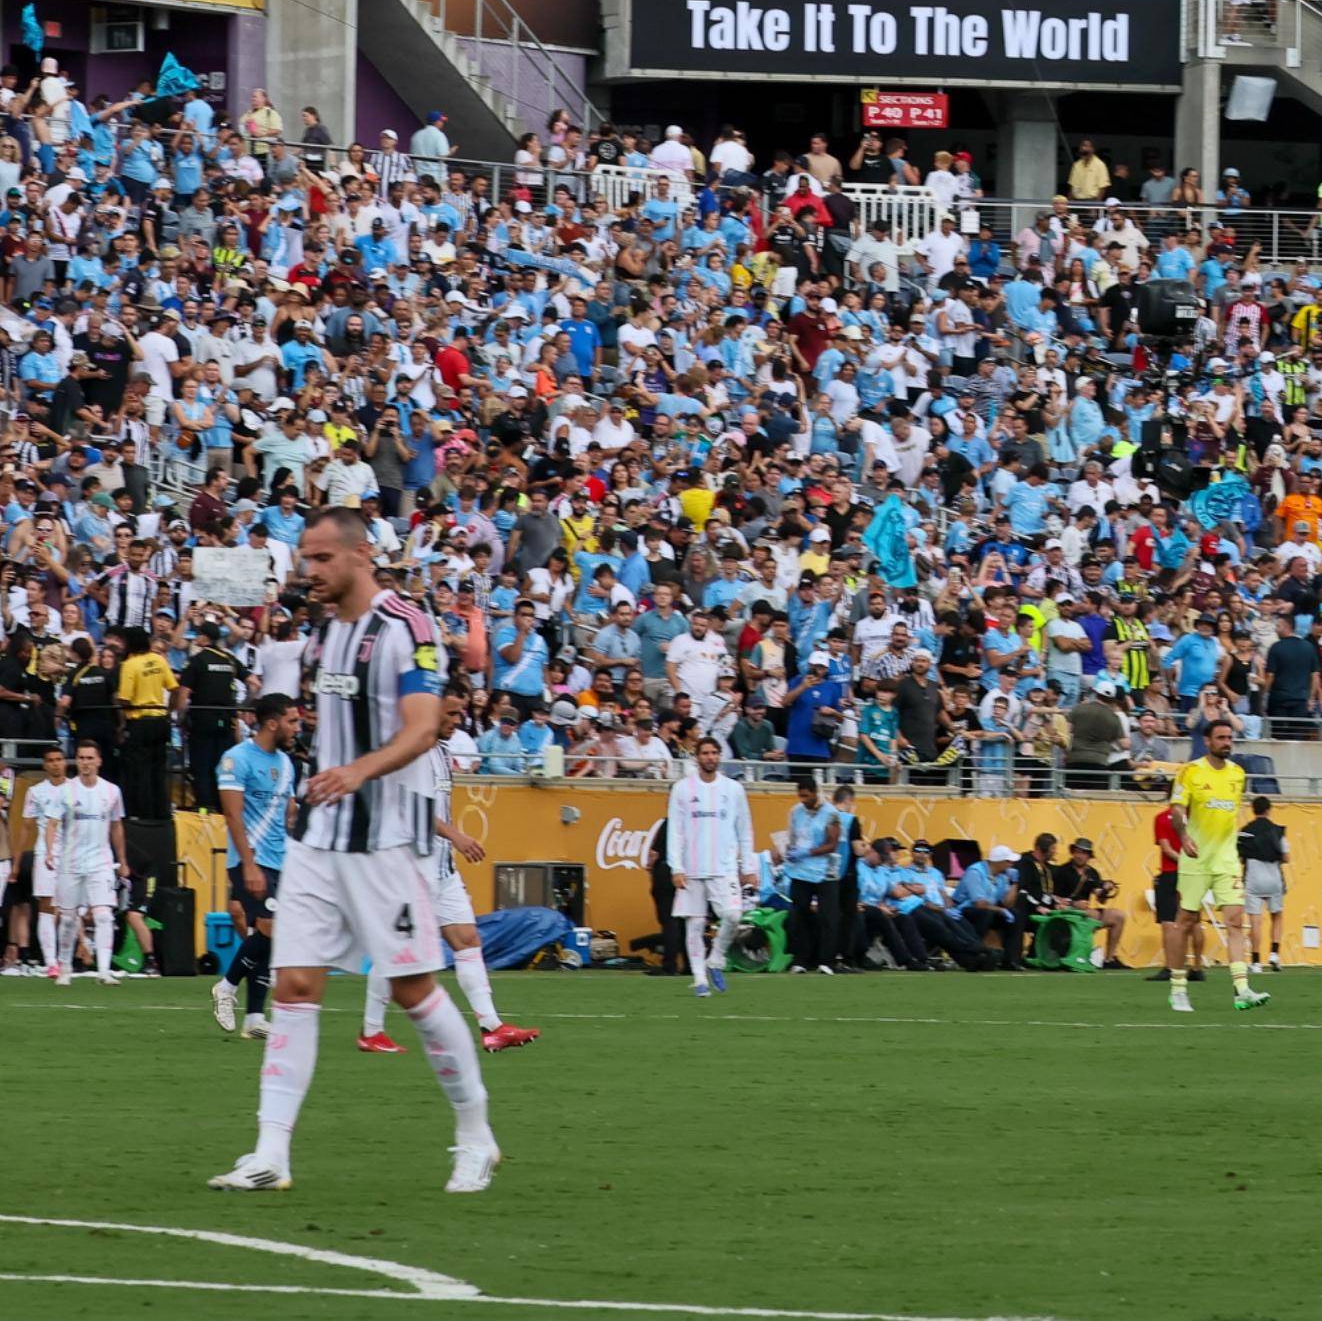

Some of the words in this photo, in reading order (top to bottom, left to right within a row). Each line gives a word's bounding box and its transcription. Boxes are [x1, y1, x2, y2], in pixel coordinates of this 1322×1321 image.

[687, 0, 791, 52] Take
[804, 3, 836, 53] It
[848, 4, 896, 55] To
[910, 6, 988, 57] The
[1001, 9, 1130, 62] World
[879, 95, 934, 105] SECTIONS
[393, 902, 416, 939] 4
